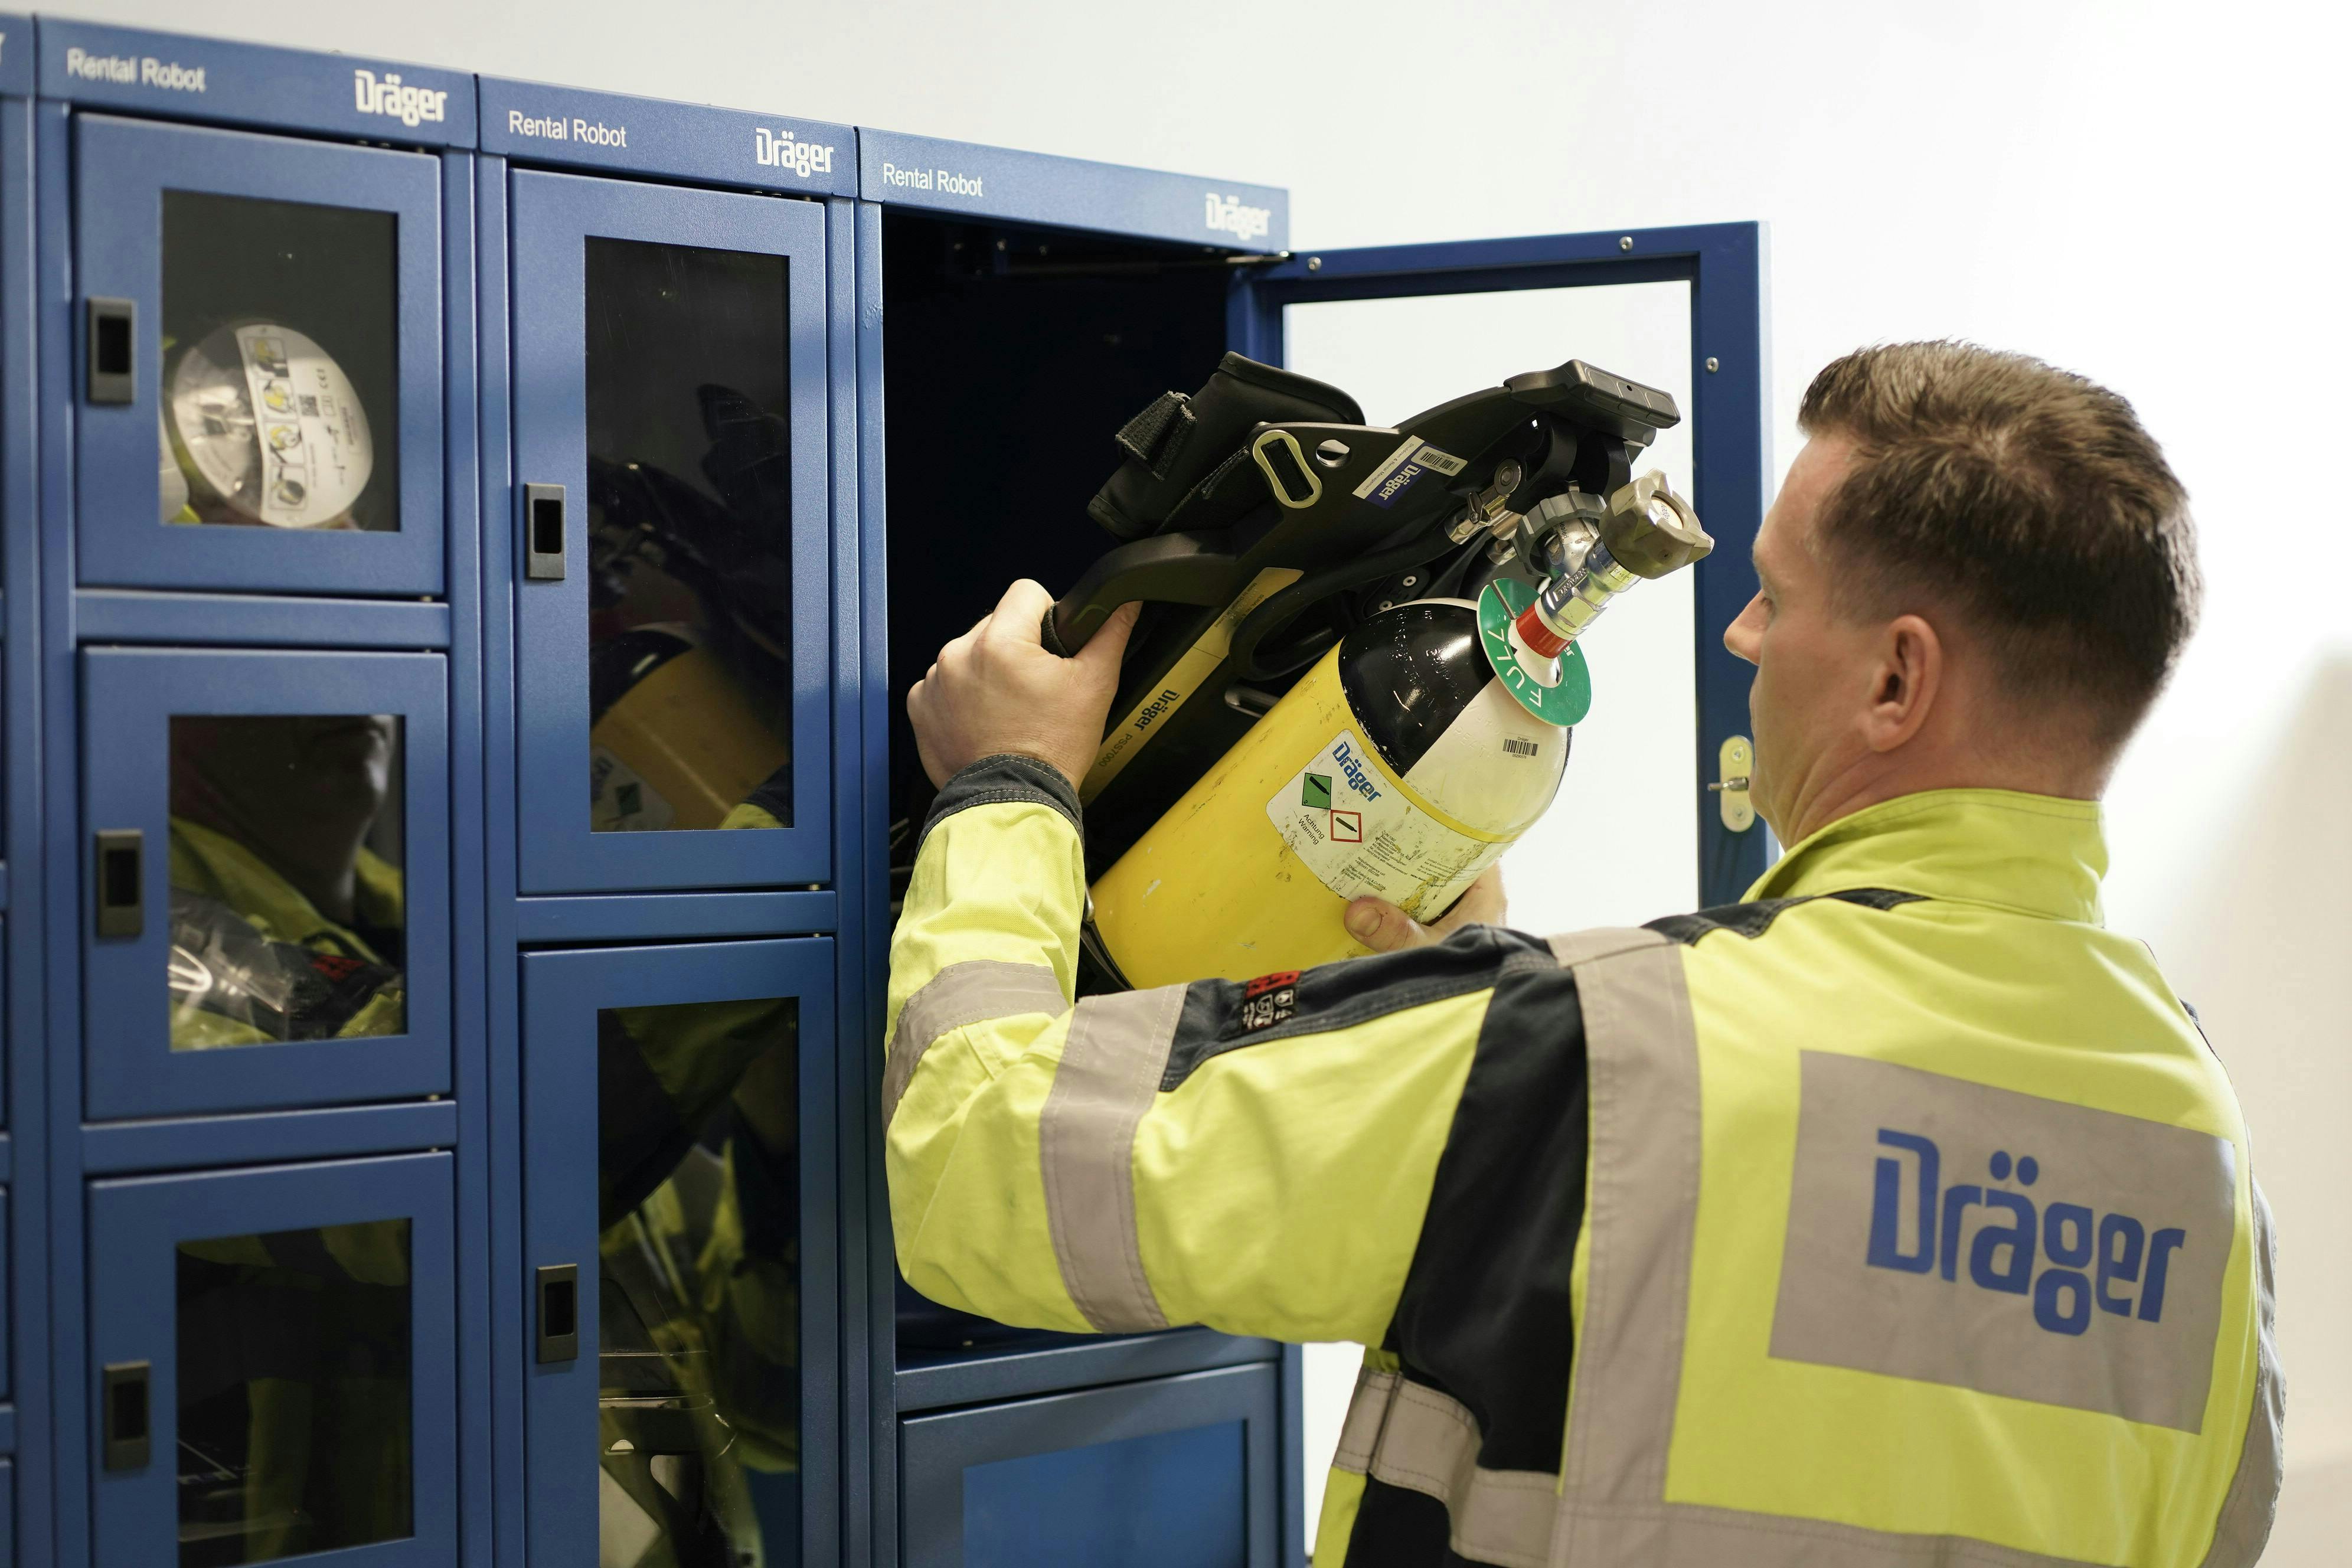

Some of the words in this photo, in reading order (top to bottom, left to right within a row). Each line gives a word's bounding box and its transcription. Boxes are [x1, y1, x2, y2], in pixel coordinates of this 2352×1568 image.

[67, 48, 137, 82] Rental
[142, 58, 205, 92] Robot
[355, 69, 447, 127] Dräger
[509, 110, 567, 140] Rental
[574, 119, 626, 147] Robot
[756, 128, 834, 177] Dräger
[884, 163, 932, 190] Rental
[937, 170, 982, 197] Robot
[1206, 193, 1270, 240] Dräger
[1383, 460, 1395, 472] Rental
[1396, 442, 1414, 459] Shutdown
[1362, 470, 1384, 492] Management
[1378, 465, 1421, 501] Dräger
[1488, 628, 1543, 708] FULL
[1134, 690, 1180, 731] Dräger
[1332, 741, 1382, 803] Dräger
[1298, 818, 1320, 845] Warning
[1303, 814, 1325, 840] Achtung
[1866, 1128, 2186, 1337] Dräger
